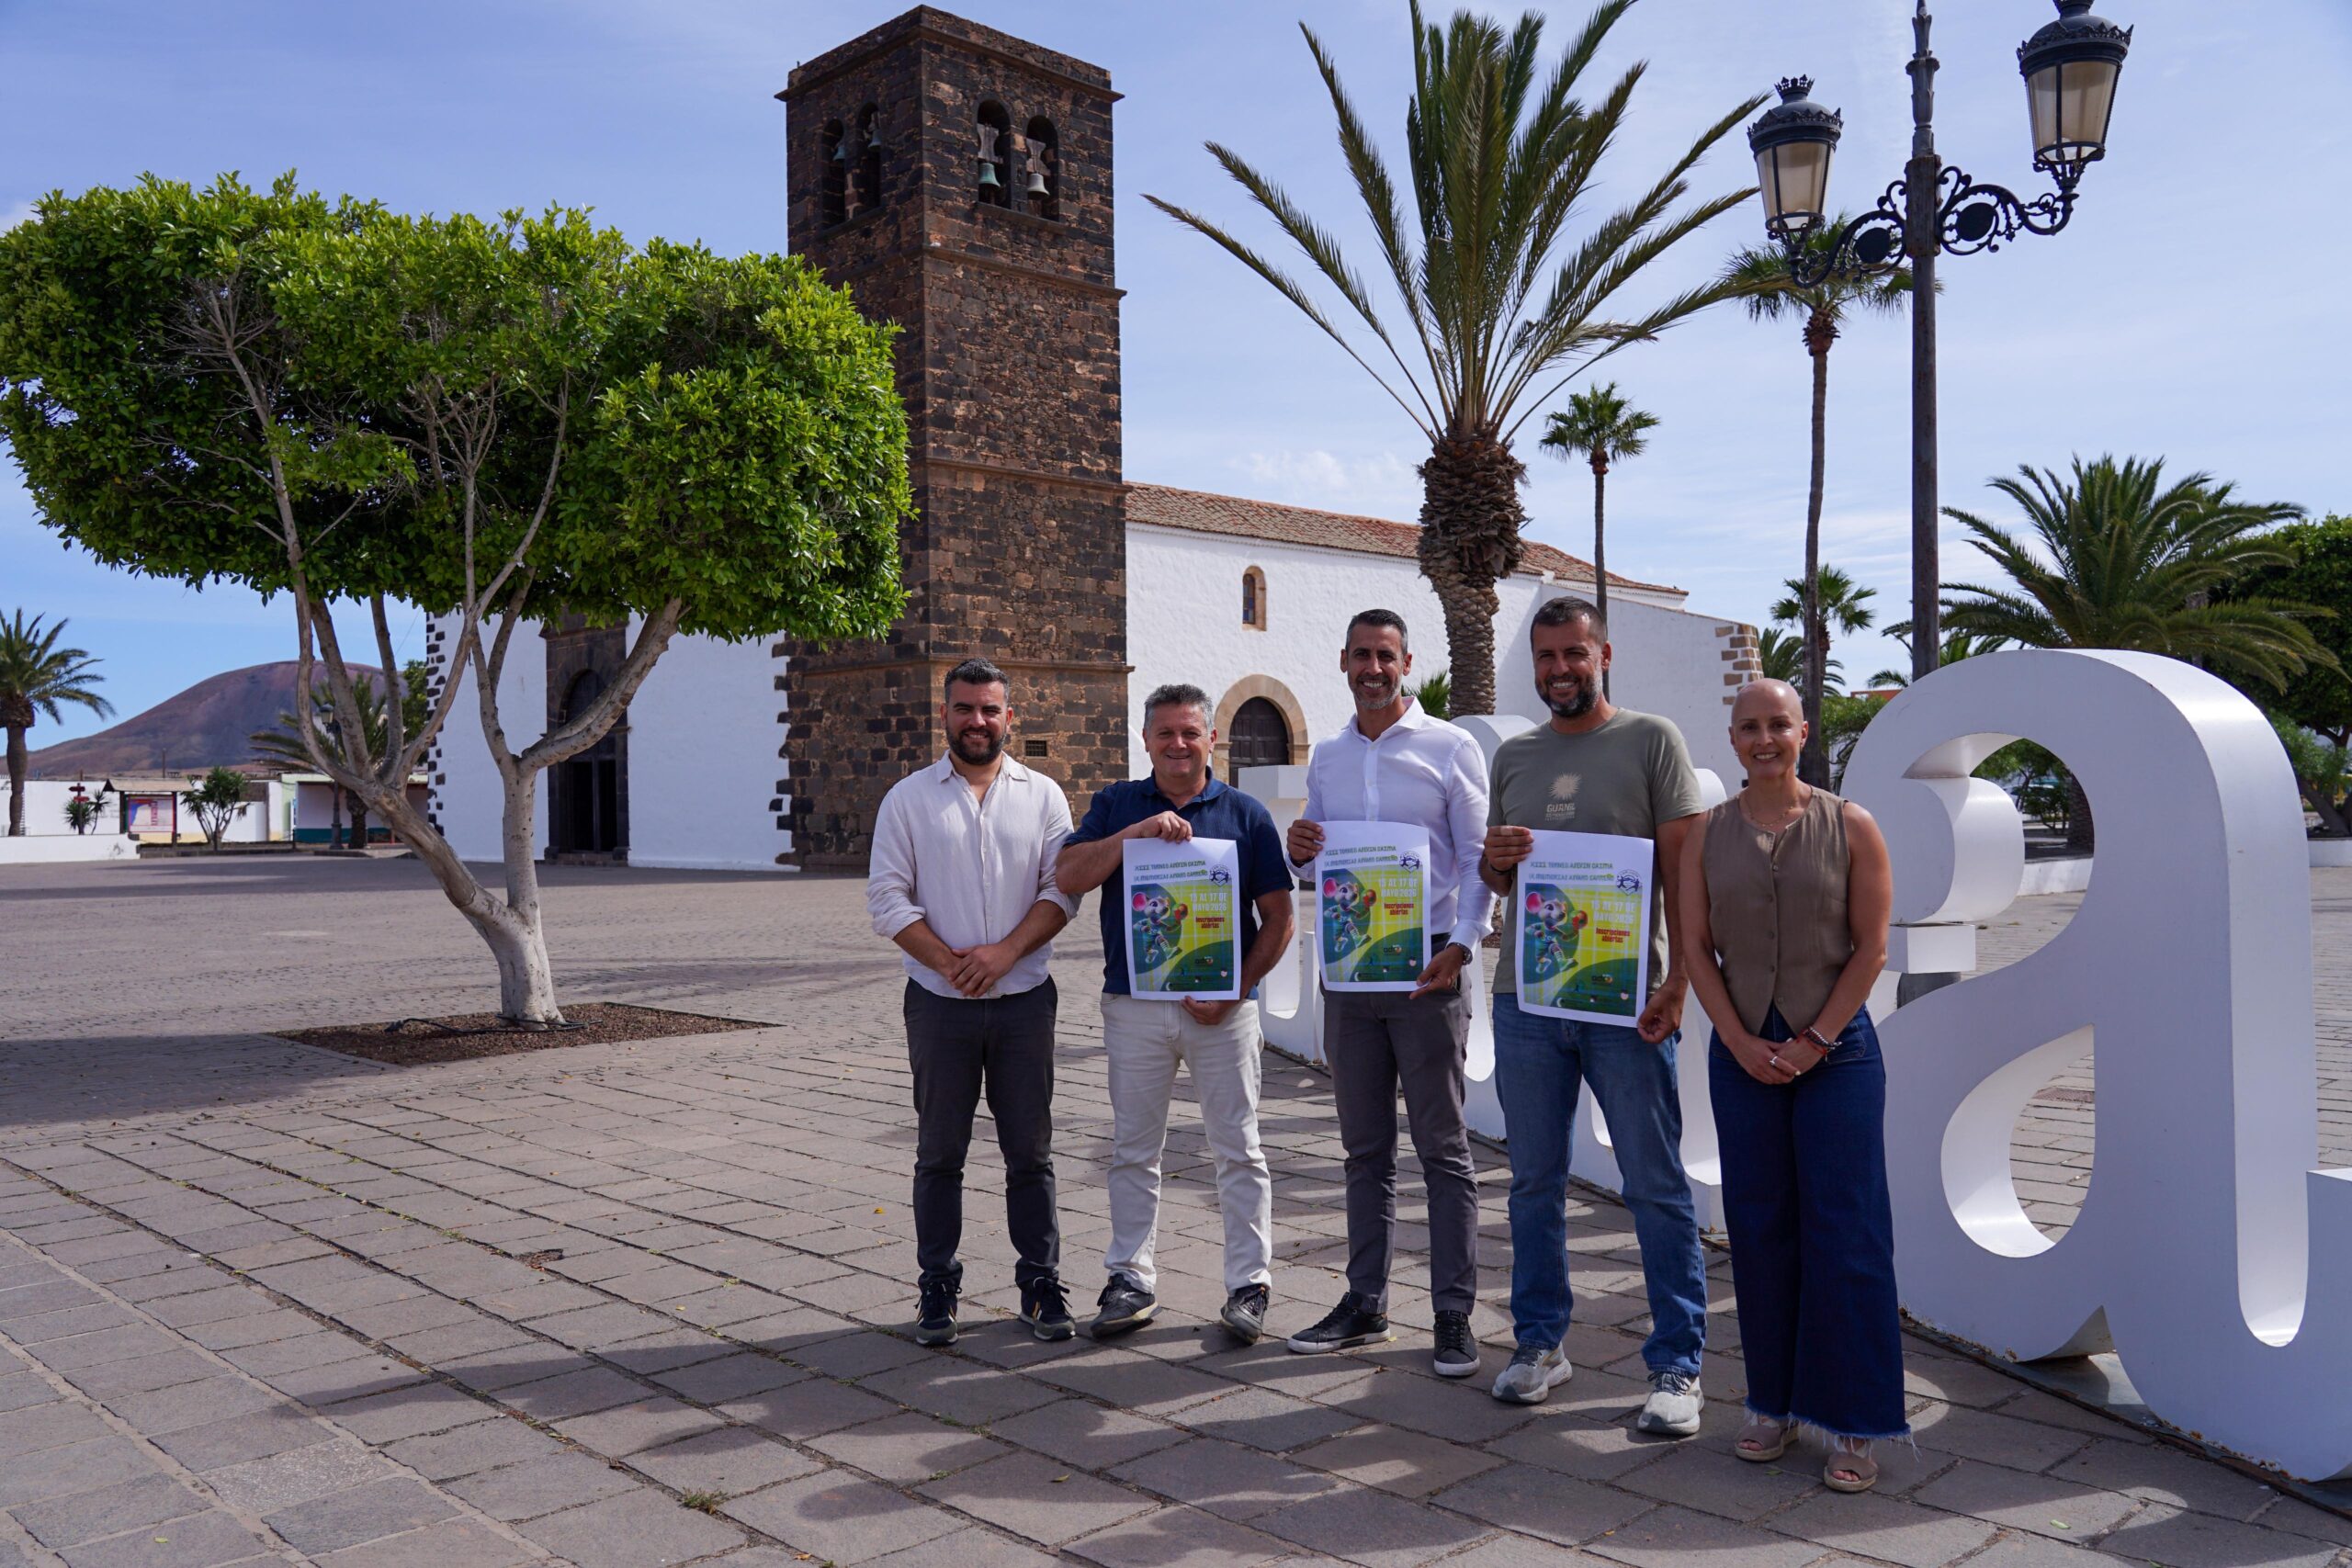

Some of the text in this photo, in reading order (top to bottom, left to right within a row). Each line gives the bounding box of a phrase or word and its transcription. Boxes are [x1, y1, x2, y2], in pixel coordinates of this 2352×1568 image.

[1388, 878, 1396, 887] AL
[1200, 893, 1208, 902] AL
[1601, 900, 1611, 910] AL
